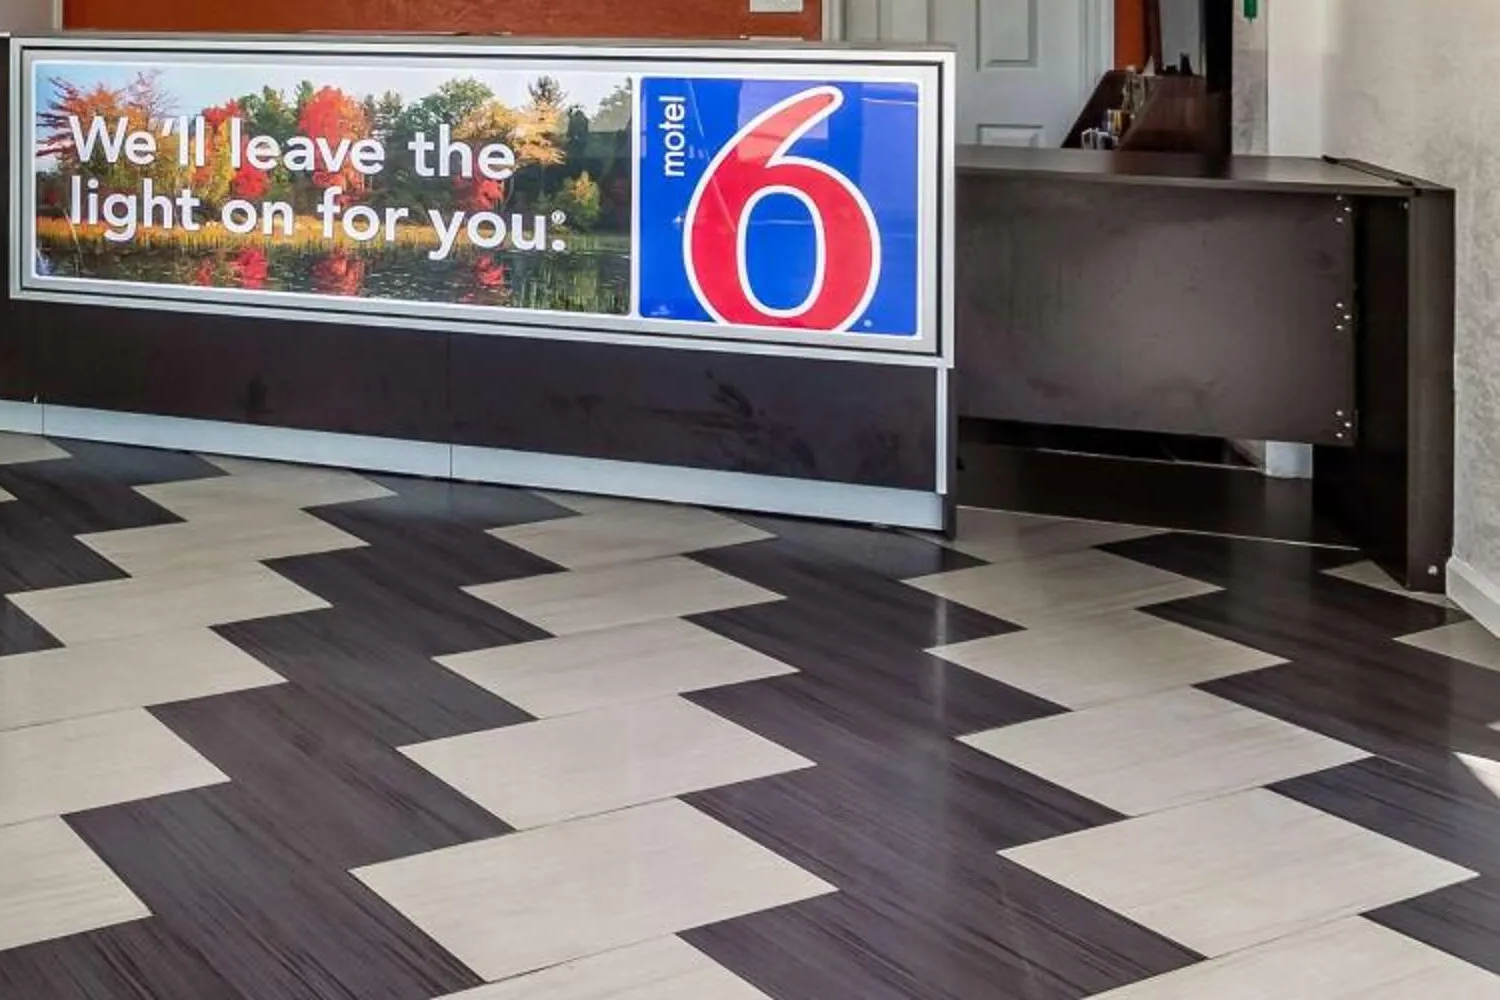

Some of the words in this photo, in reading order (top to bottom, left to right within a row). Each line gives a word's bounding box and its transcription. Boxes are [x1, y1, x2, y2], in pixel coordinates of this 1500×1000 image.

[68, 115, 205, 167] We'll
[231, 117, 385, 174] leave
[408, 124, 516, 180] the
[658, 96, 686, 177] motel
[70, 175, 201, 242] light
[221, 199, 294, 236] on
[317, 186, 409, 241] for
[683, 85, 881, 332] 6
